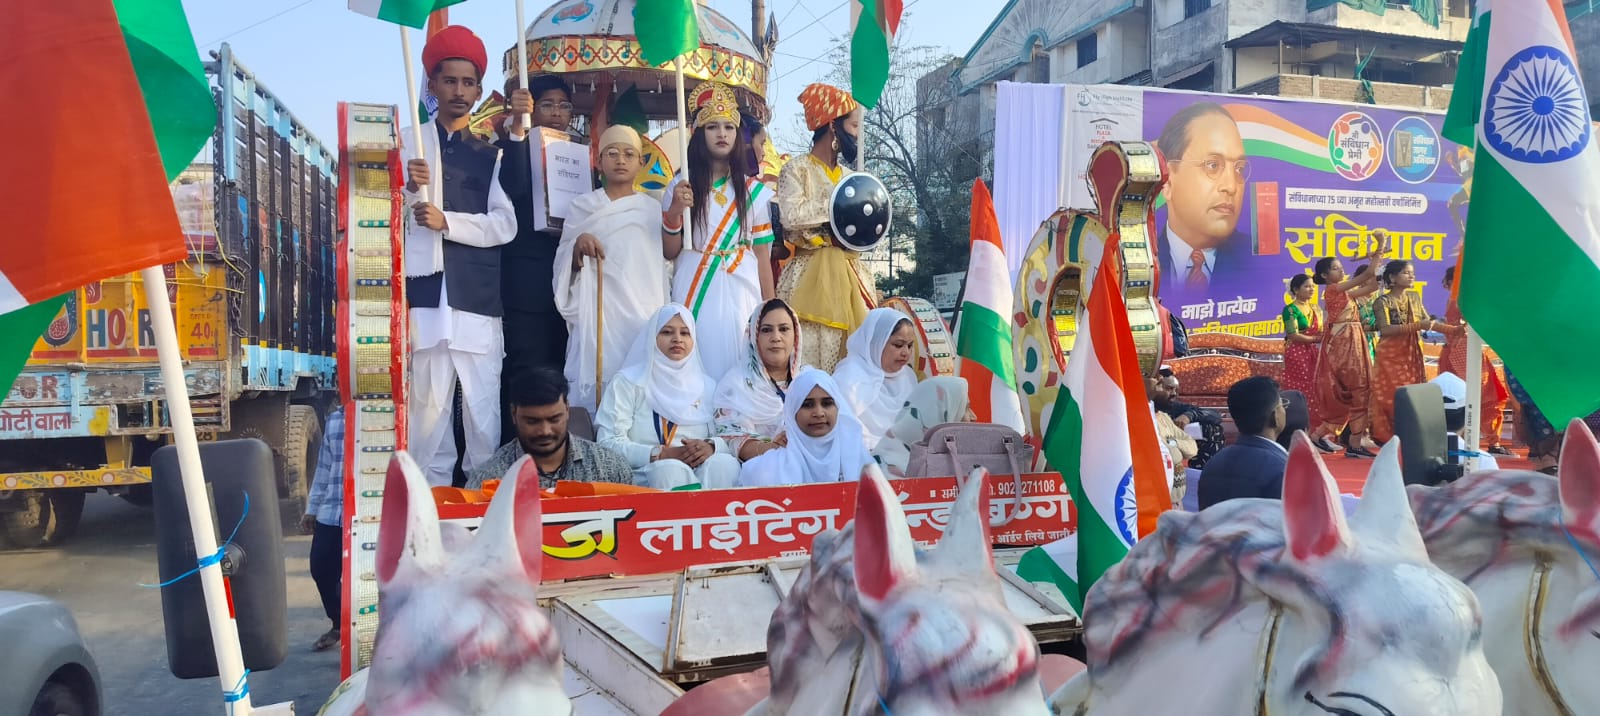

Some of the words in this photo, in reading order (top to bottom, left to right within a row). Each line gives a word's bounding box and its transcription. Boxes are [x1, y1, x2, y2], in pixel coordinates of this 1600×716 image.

[1340, 137, 1370, 150] संविधान
[1285, 213, 1447, 264] संविधान
[1181, 299, 1215, 320] माझे
[1217, 296, 1258, 318] प्रत्येक
[86, 308, 177, 349] HOR
[35, 412, 71, 431] वाला
[998, 480, 1055, 495] 902271108
[636, 498, 840, 555] लाईटिंग
